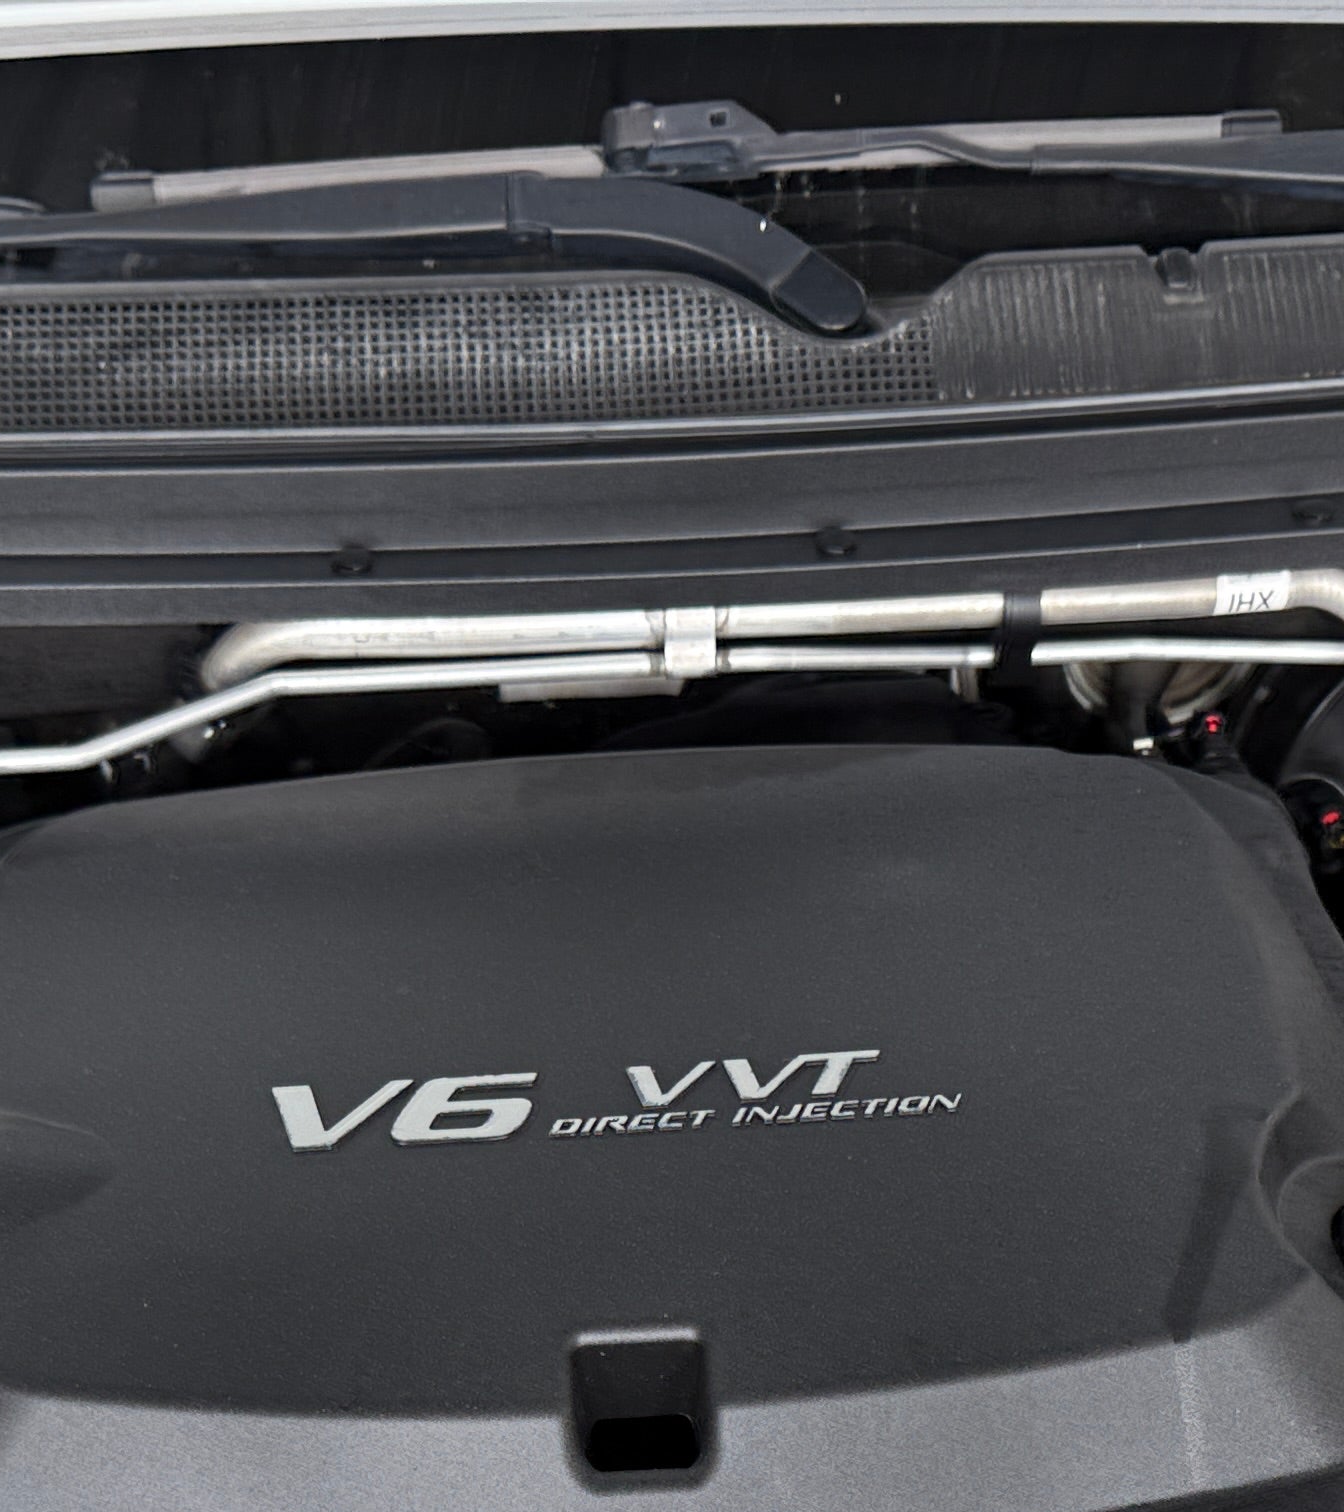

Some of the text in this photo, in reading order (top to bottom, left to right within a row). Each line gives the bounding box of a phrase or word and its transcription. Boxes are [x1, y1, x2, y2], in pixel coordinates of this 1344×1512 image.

[271, 1049, 881, 1153] V6 VVT
[548, 1092, 963, 1138] DIRECT INJECTION
